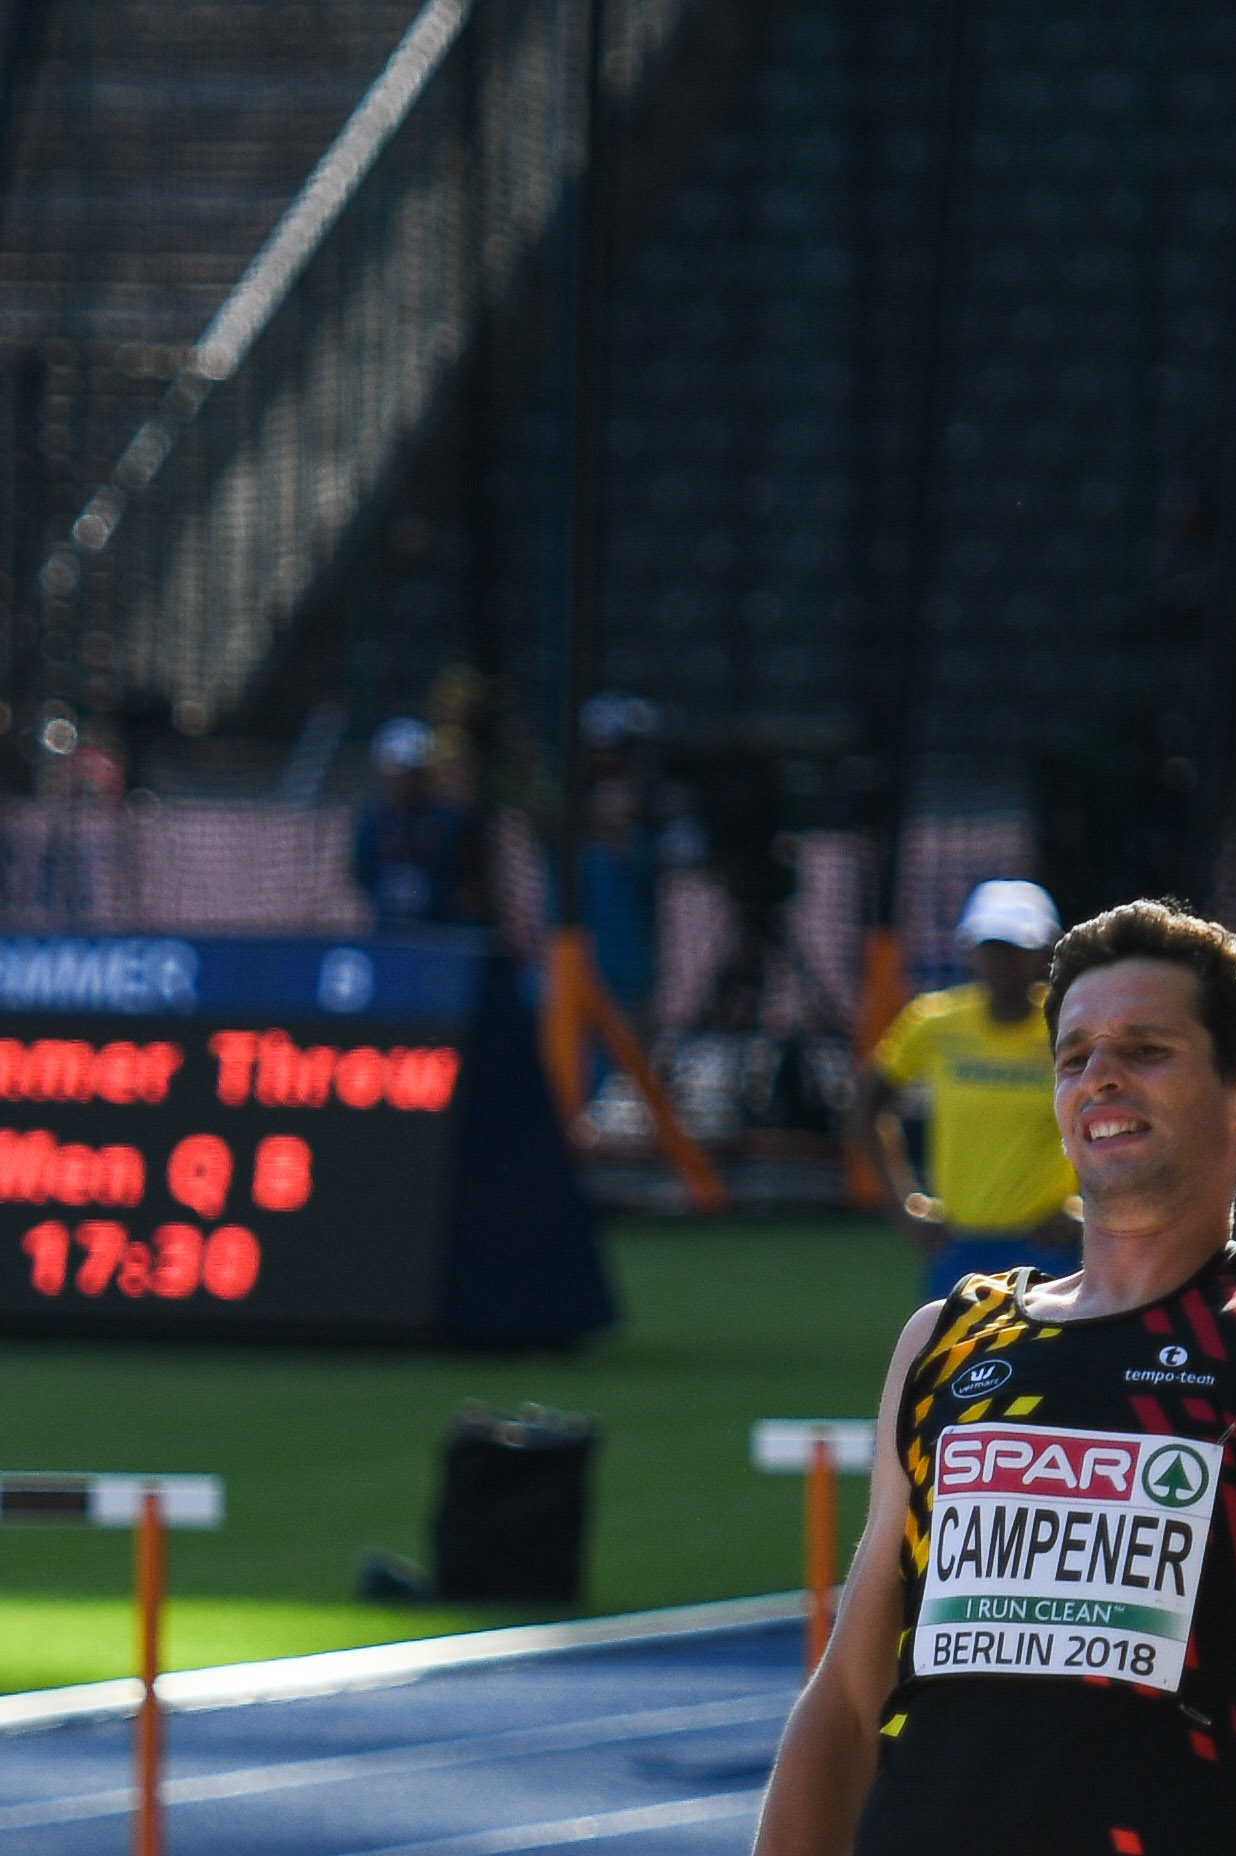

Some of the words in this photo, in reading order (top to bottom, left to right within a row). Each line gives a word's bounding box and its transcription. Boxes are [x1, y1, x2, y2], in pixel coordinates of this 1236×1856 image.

[208, 1028, 460, 1112] Throw
[167, 1133, 233, 1220] Q
[22, 1219, 261, 1300] 17:30
[1124, 1368, 1216, 1386] tempo-team
[943, 1440, 1132, 1492] SPAR
[937, 1505, 1193, 1597] CAMPENER
[966, 1598, 973, 1619] I
[978, 1598, 1028, 1619] RUN
[933, 1631, 1054, 1666] BERLIN
[1064, 1635, 1157, 1676] 2018
